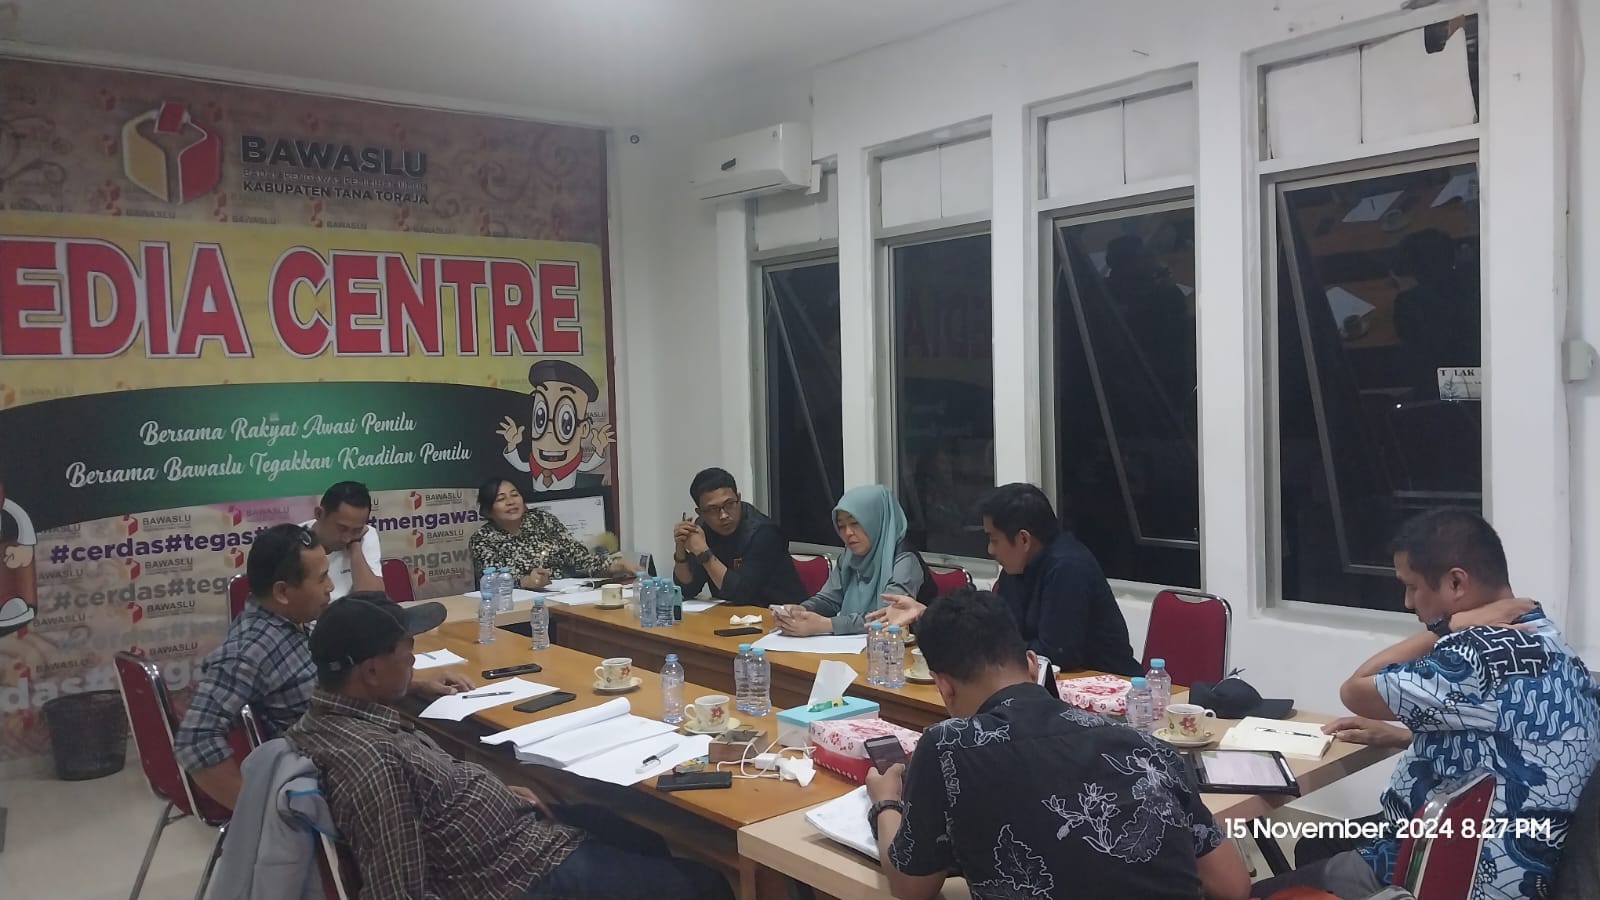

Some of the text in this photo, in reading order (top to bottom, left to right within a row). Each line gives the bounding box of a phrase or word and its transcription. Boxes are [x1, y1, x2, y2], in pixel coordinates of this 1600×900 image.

[240, 136, 427, 177] BAWASLU
[243, 181, 429, 205] KABUPATEN TANA TORAJA
[268, 246, 583, 358] CENTRE
[139, 411, 416, 446] Bersama Rakyat Awasi Pemilu
[66, 441, 472, 488] Bersama Bawaslu Tegakkan Keadilan Pemilu
[426, 490, 462, 501] BAWASLU
[143, 514, 191, 526] BAWASLU
[427, 529, 463, 539] BAWASLU
[144, 557, 193, 569] BAWASLU
[147, 600, 196, 612] BAWASLU
